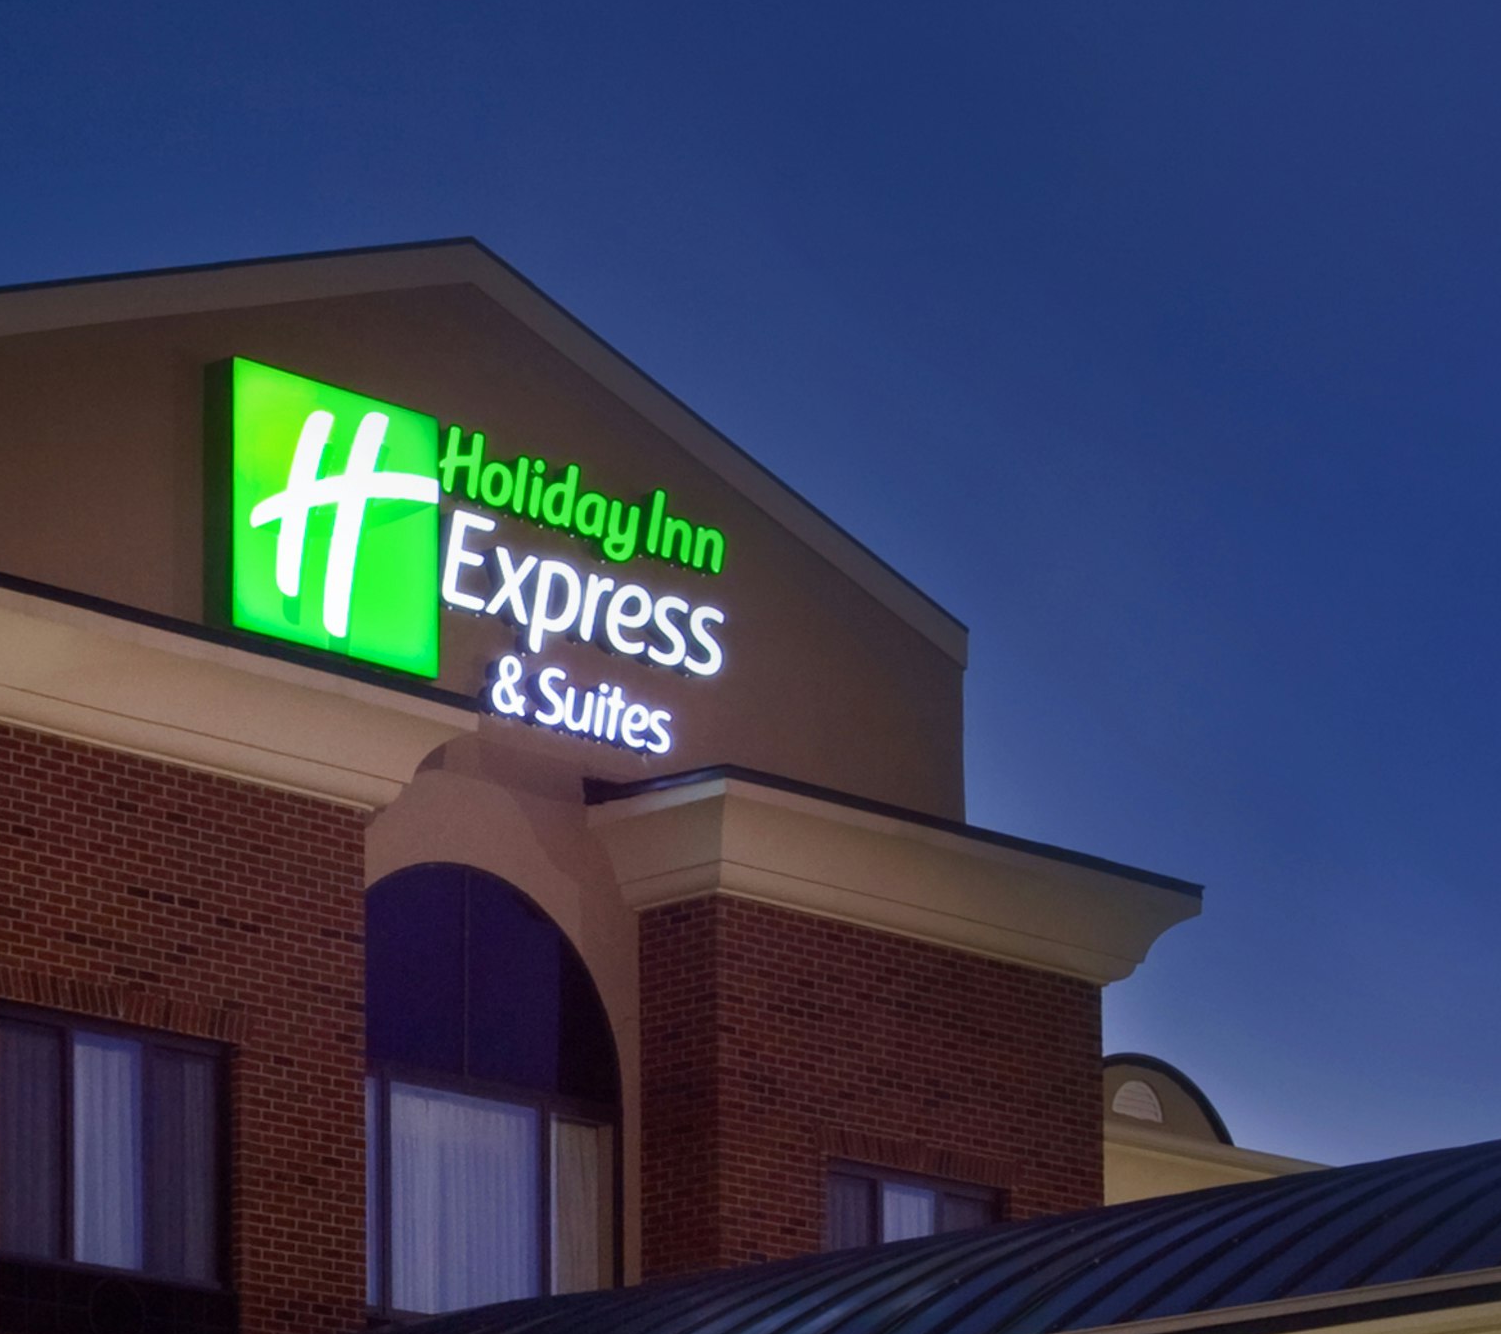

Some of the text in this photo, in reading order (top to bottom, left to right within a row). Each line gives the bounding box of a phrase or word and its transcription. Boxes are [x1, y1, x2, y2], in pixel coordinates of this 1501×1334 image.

[439, 425, 724, 573] Holiday Inn
[441, 509, 725, 676] Express
[491, 655, 672, 754] & Suites
